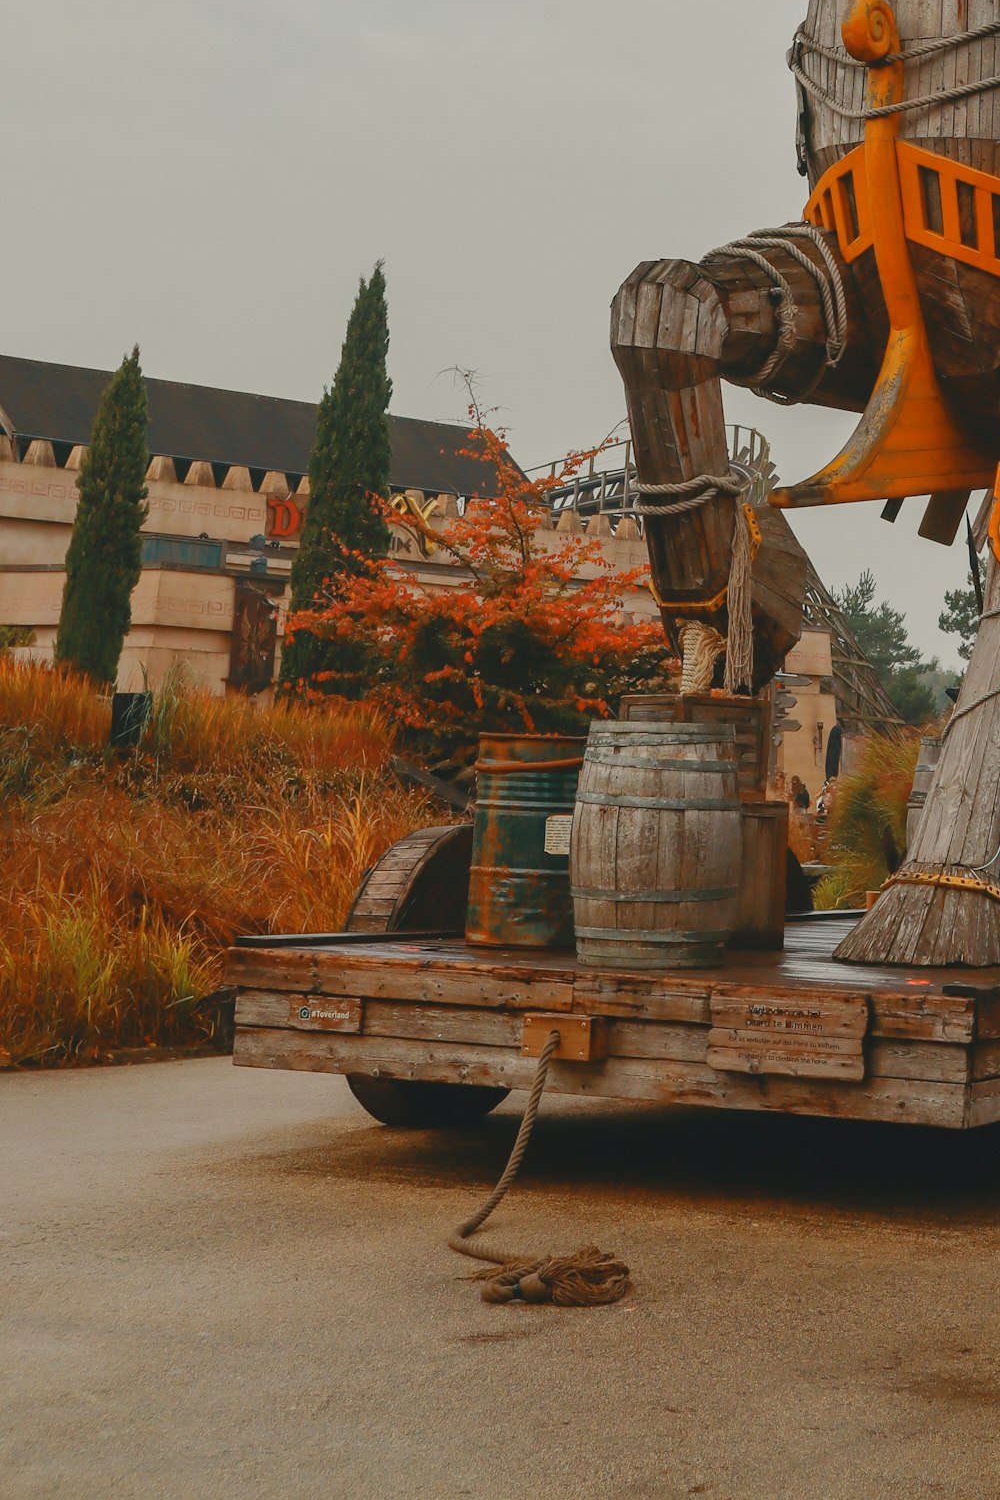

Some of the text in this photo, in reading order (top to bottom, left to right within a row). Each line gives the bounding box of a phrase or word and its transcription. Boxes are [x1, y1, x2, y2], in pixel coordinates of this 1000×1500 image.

[311, 1010, 350, 1019] #Toverland
[774, 1019, 782, 1027] te
[746, 1036, 771, 1044] verboten
[793, 1039, 808, 1047] Pferd
[800, 1056, 811, 1064] the
